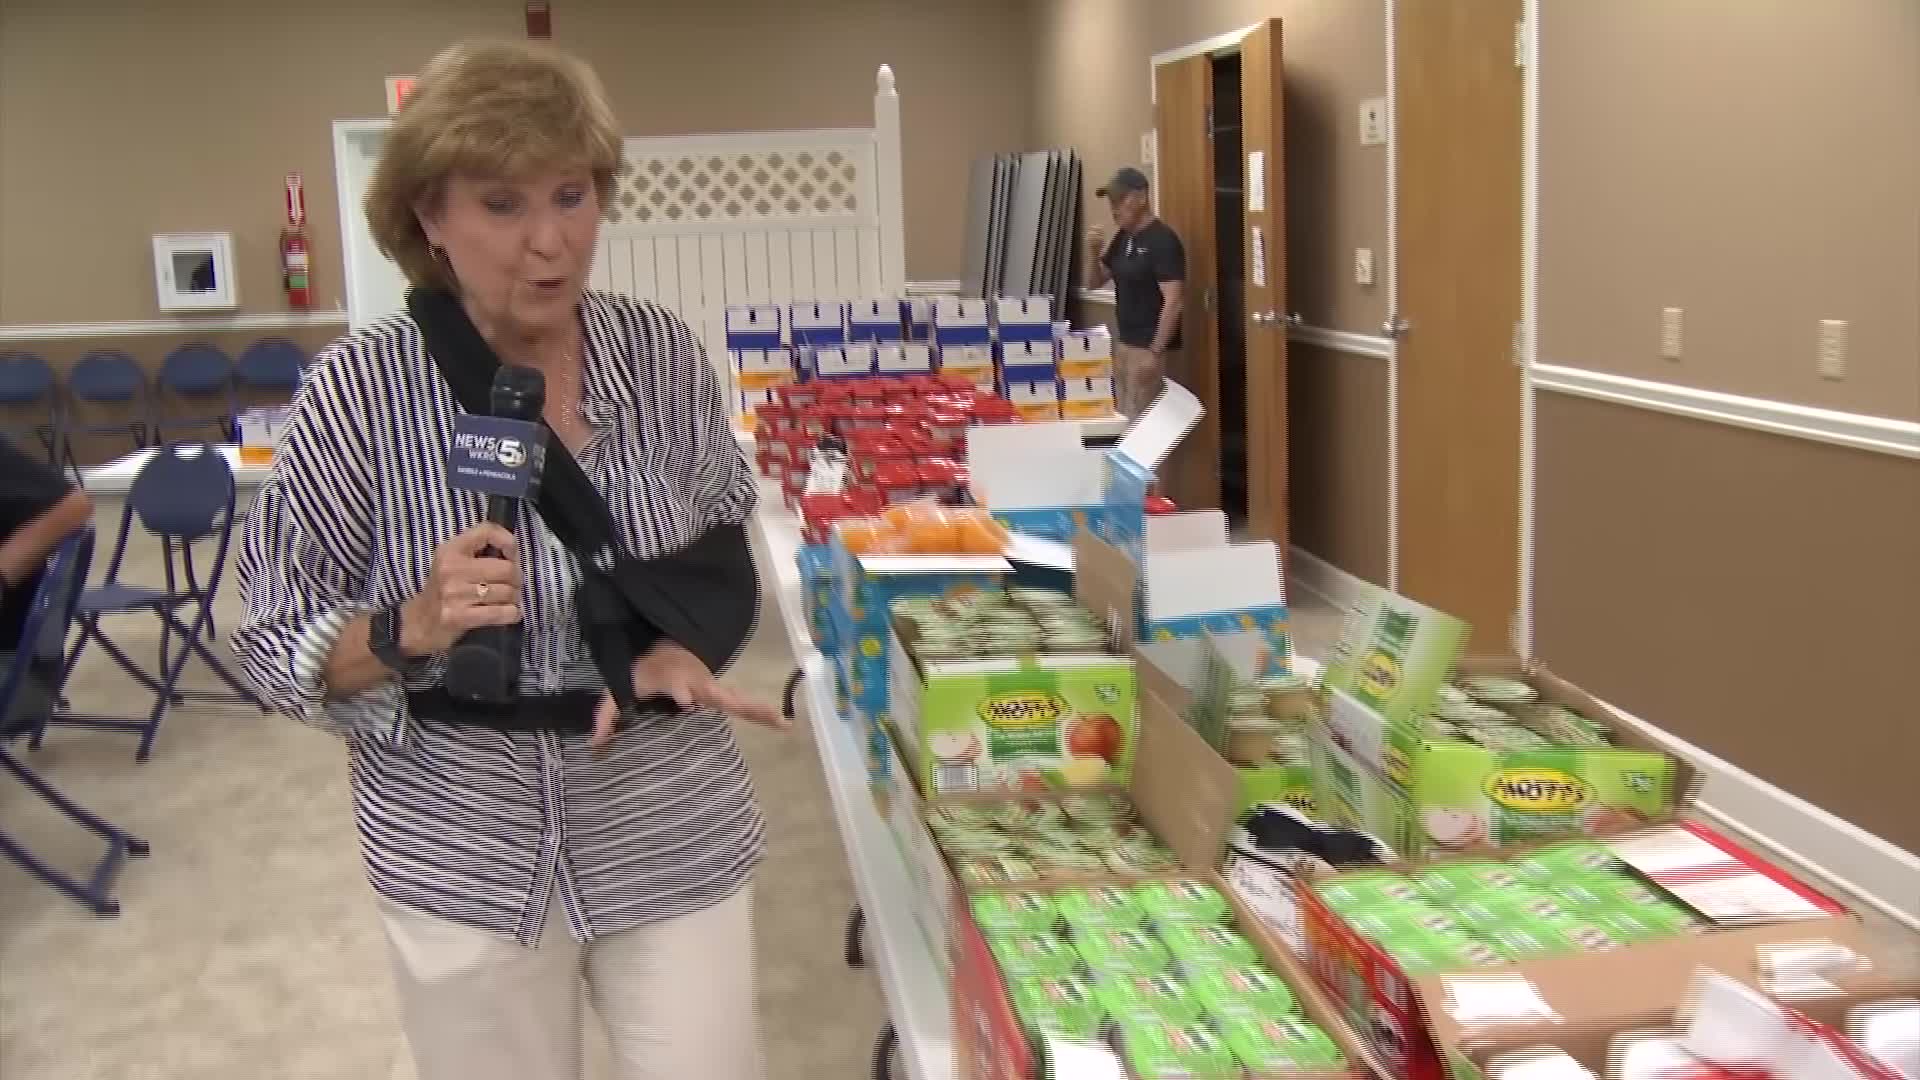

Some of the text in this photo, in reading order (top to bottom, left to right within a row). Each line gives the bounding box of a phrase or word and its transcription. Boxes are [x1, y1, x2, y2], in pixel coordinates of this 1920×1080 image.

[455, 432, 496, 449] NEWS
[498, 438, 525, 466] 5
[987, 700, 1061, 719] MOTT'S
[1494, 778, 1584, 803] MOTT'S
